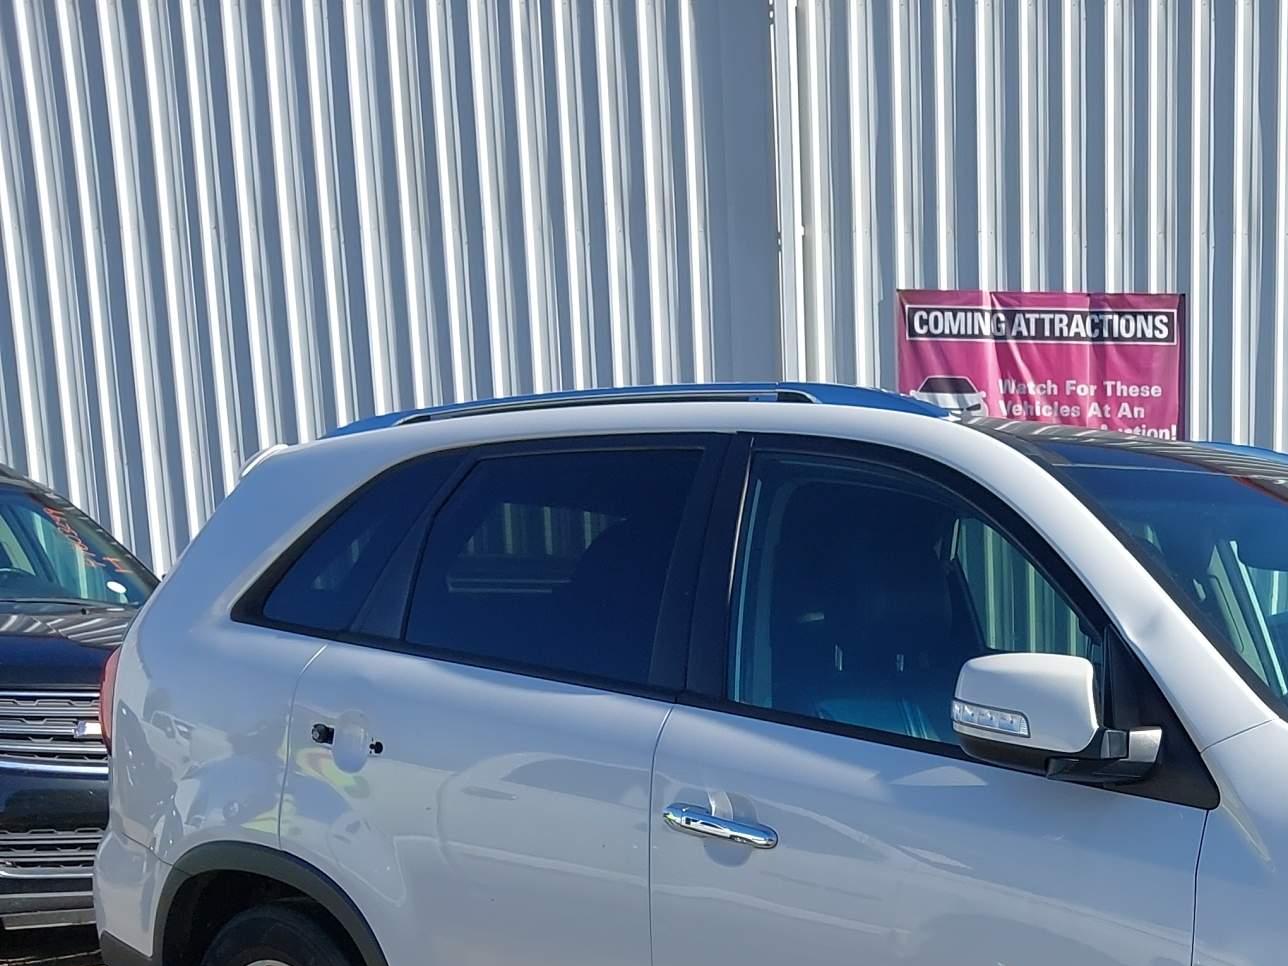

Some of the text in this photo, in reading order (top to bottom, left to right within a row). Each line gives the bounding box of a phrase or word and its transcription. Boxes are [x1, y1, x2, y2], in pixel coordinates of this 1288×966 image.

[912, 310, 1169, 339] COMING ATTRACTIONS
[997, 379, 1162, 397] Watch For These
[999, 402, 1145, 418] Vehicles At An
